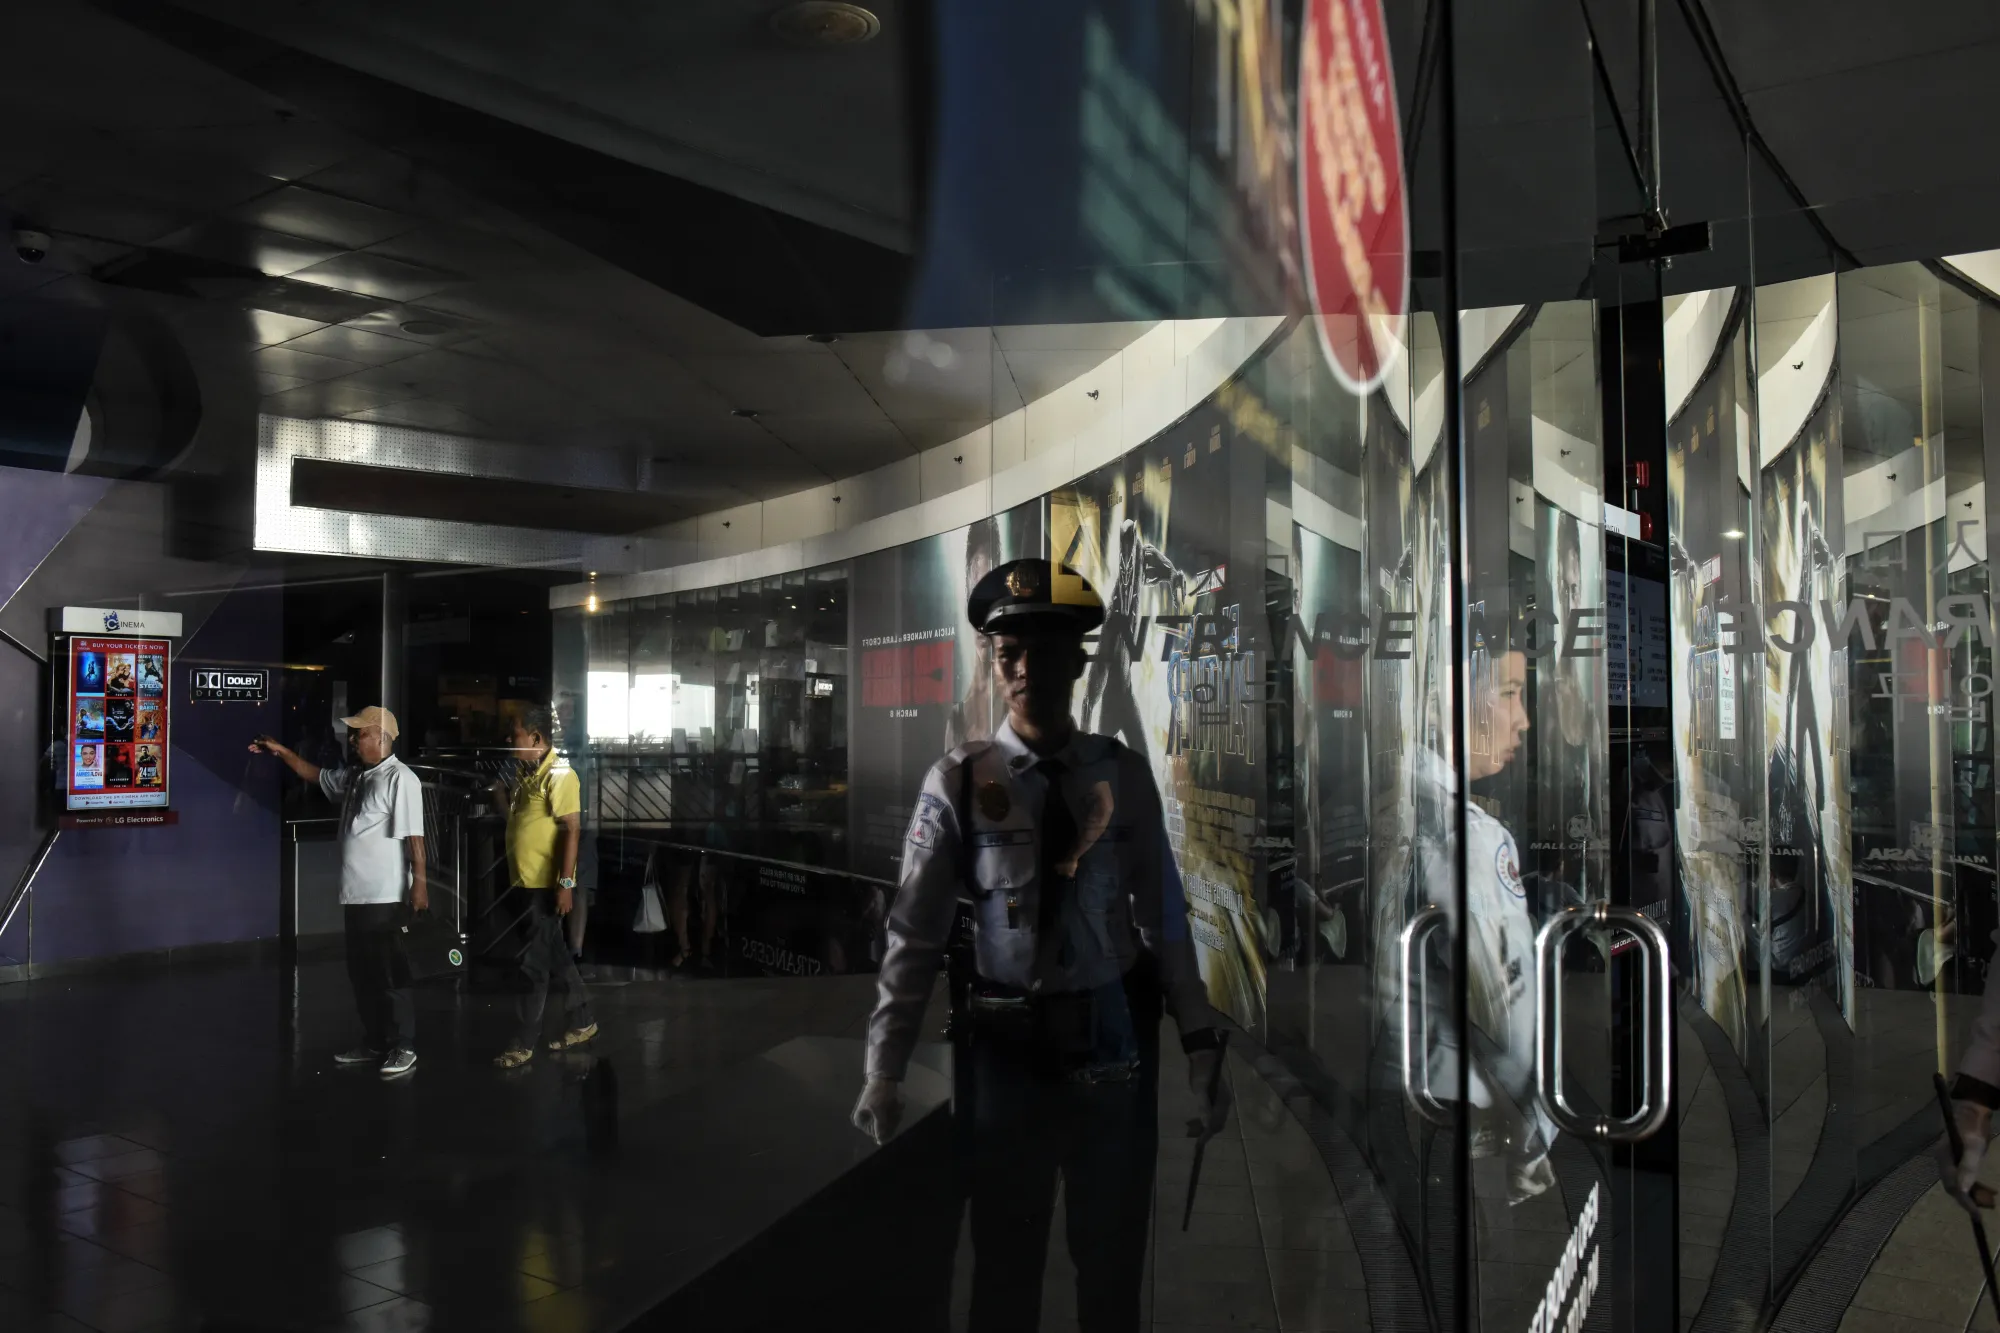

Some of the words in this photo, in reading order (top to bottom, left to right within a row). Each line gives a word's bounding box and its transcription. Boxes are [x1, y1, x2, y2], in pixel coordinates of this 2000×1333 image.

[106, 619, 145, 631] CINEMA
[227, 676, 258, 686] DOLBY
[196, 689, 262, 698] DIGITAL
[1529, 842, 1566, 850] MALL
